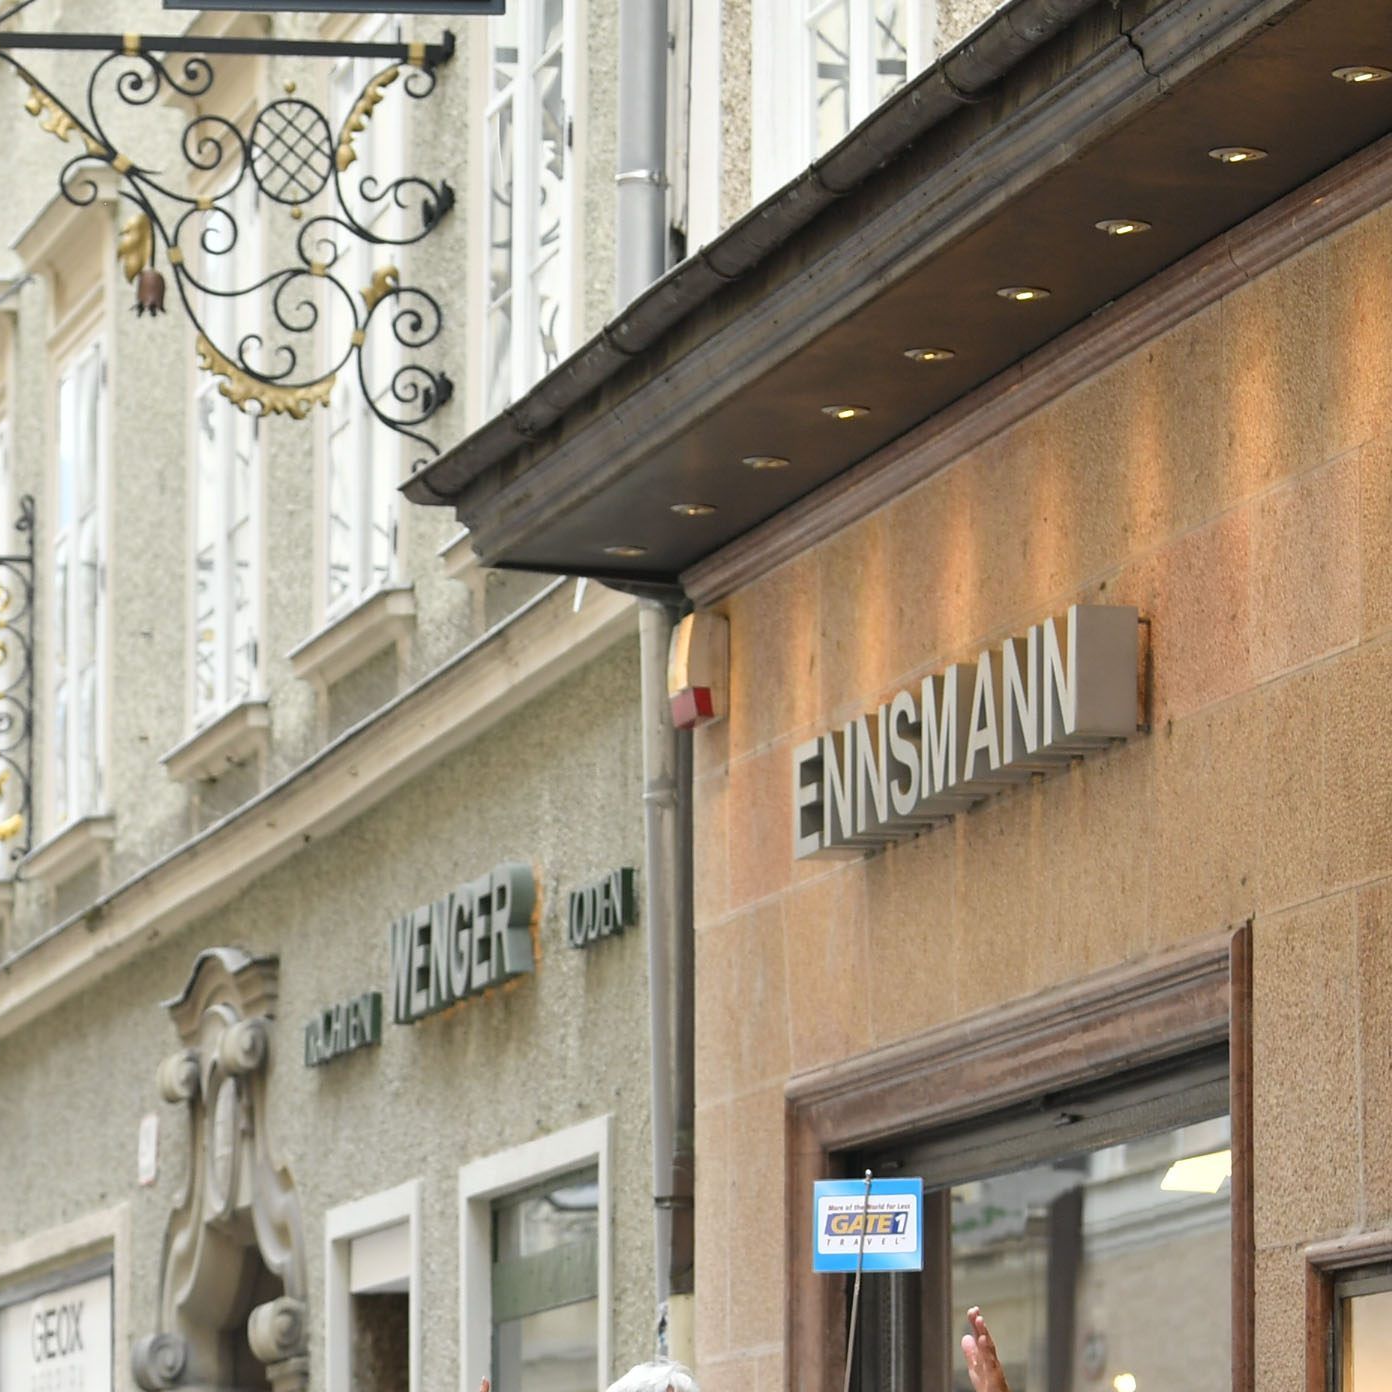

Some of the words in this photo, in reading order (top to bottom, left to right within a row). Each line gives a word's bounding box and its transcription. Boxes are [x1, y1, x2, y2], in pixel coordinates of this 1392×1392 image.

[792, 604, 1082, 861] ENNSMANN
[389, 861, 526, 1025] WENGER
[31, 1300, 84, 1362] GEOX
